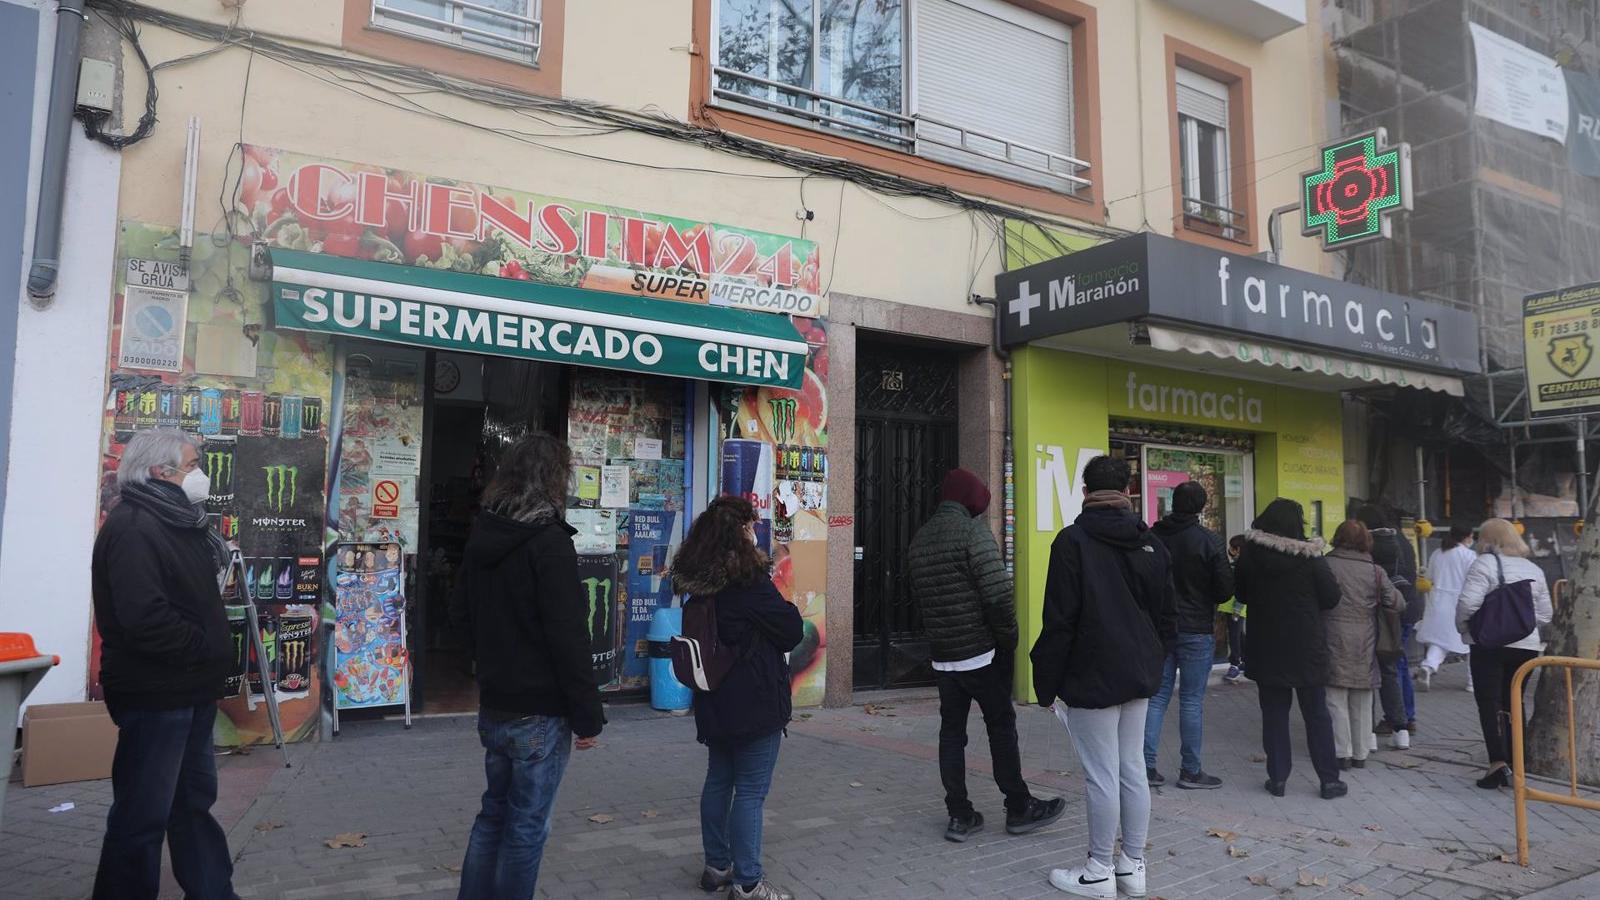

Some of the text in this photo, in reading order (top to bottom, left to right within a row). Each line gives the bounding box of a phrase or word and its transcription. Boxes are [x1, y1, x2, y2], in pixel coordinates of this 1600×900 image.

[130, 259, 187, 278] SE AVISA
[1077, 260, 1139, 286] farmacia
[141, 272, 174, 289] GRUA
[630, 272, 812, 313] SUPER MERCADO
[1048, 277, 1140, 311] Marañón
[1218, 256, 1438, 350] farmacia
[302, 286, 789, 381] SUPERMERCADO CHEN
[1532, 327, 1545, 339] 91
[1237, 341, 1407, 386] ORTOPEDIA
[1126, 370, 1263, 424] farmacia
[252, 517, 306, 527] MONSTER
[634, 515, 660, 524] RED BULL
[634, 523, 650, 531] TE DA
[631, 598, 657, 606] RED BULL
[631, 606, 648, 614] TE DA
